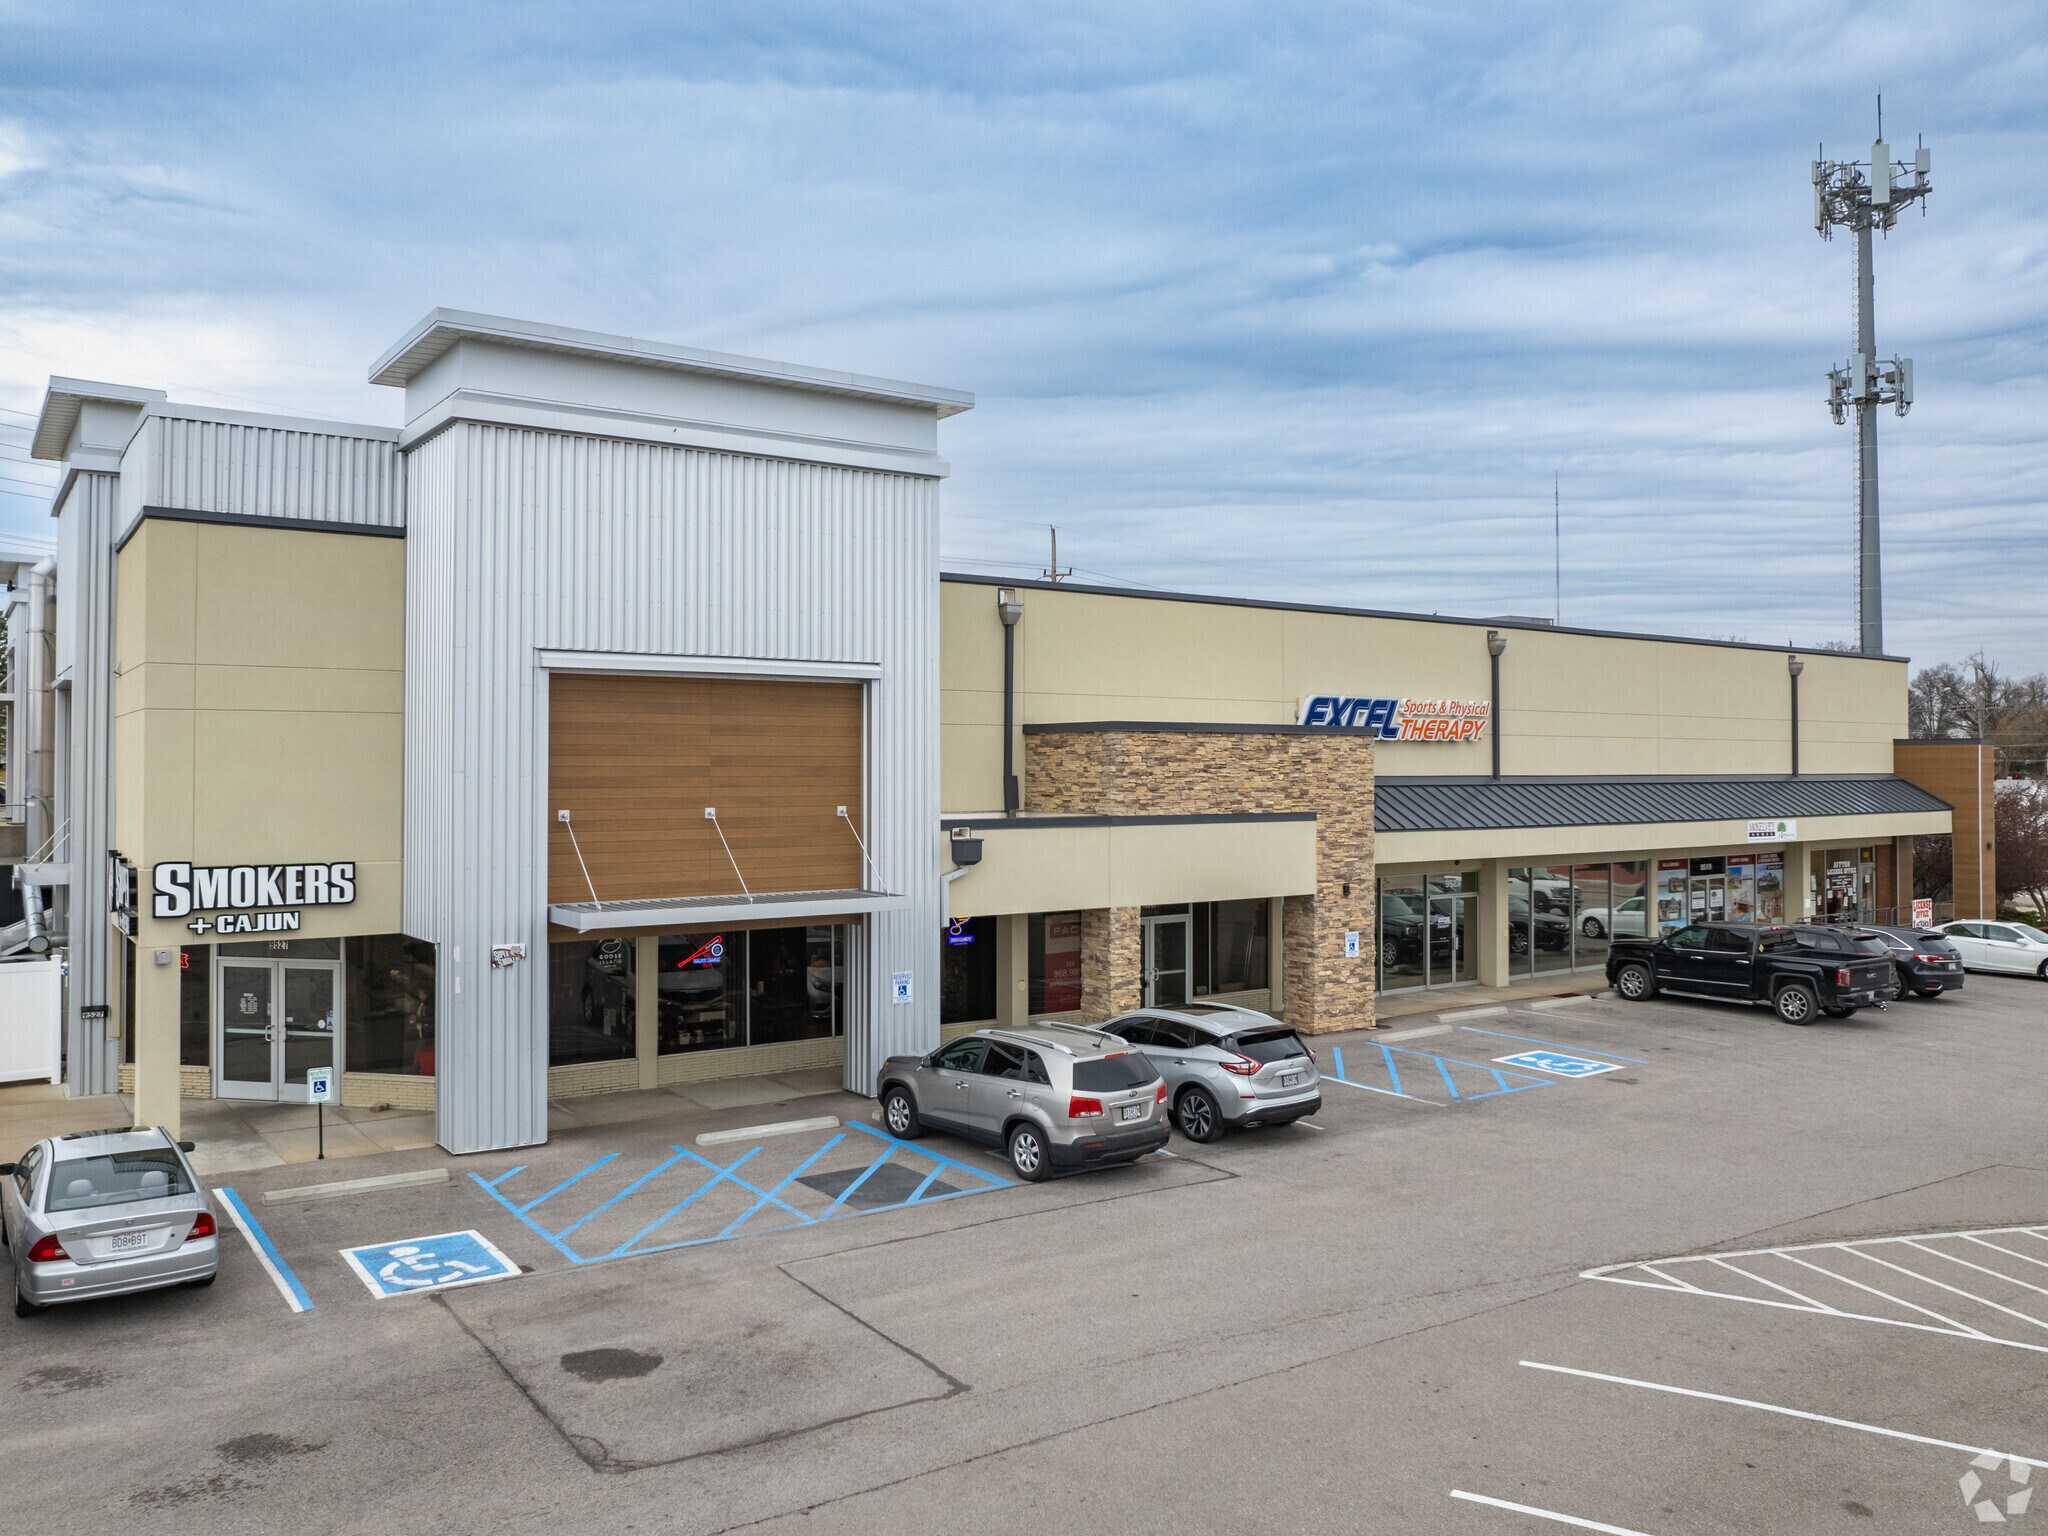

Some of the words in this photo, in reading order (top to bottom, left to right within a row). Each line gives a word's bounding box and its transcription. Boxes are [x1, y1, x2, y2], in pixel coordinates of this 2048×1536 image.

[1403, 699, 1436, 716] Sports
[1438, 702, 1447, 713] &
[1449, 701, 1490, 717] Physical
[1400, 719, 1486, 740] THERAPY
[1700, 863, 1712, 871] 9519
[153, 862, 356, 918] SMOKERS
[1914, 900, 1931, 911] LICENSE
[1916, 910, 1929, 919] OFFICE
[216, 911, 301, 935] CAJUN
[270, 940, 288, 949] 9527
[1053, 968, 1080, 978] 968.98
